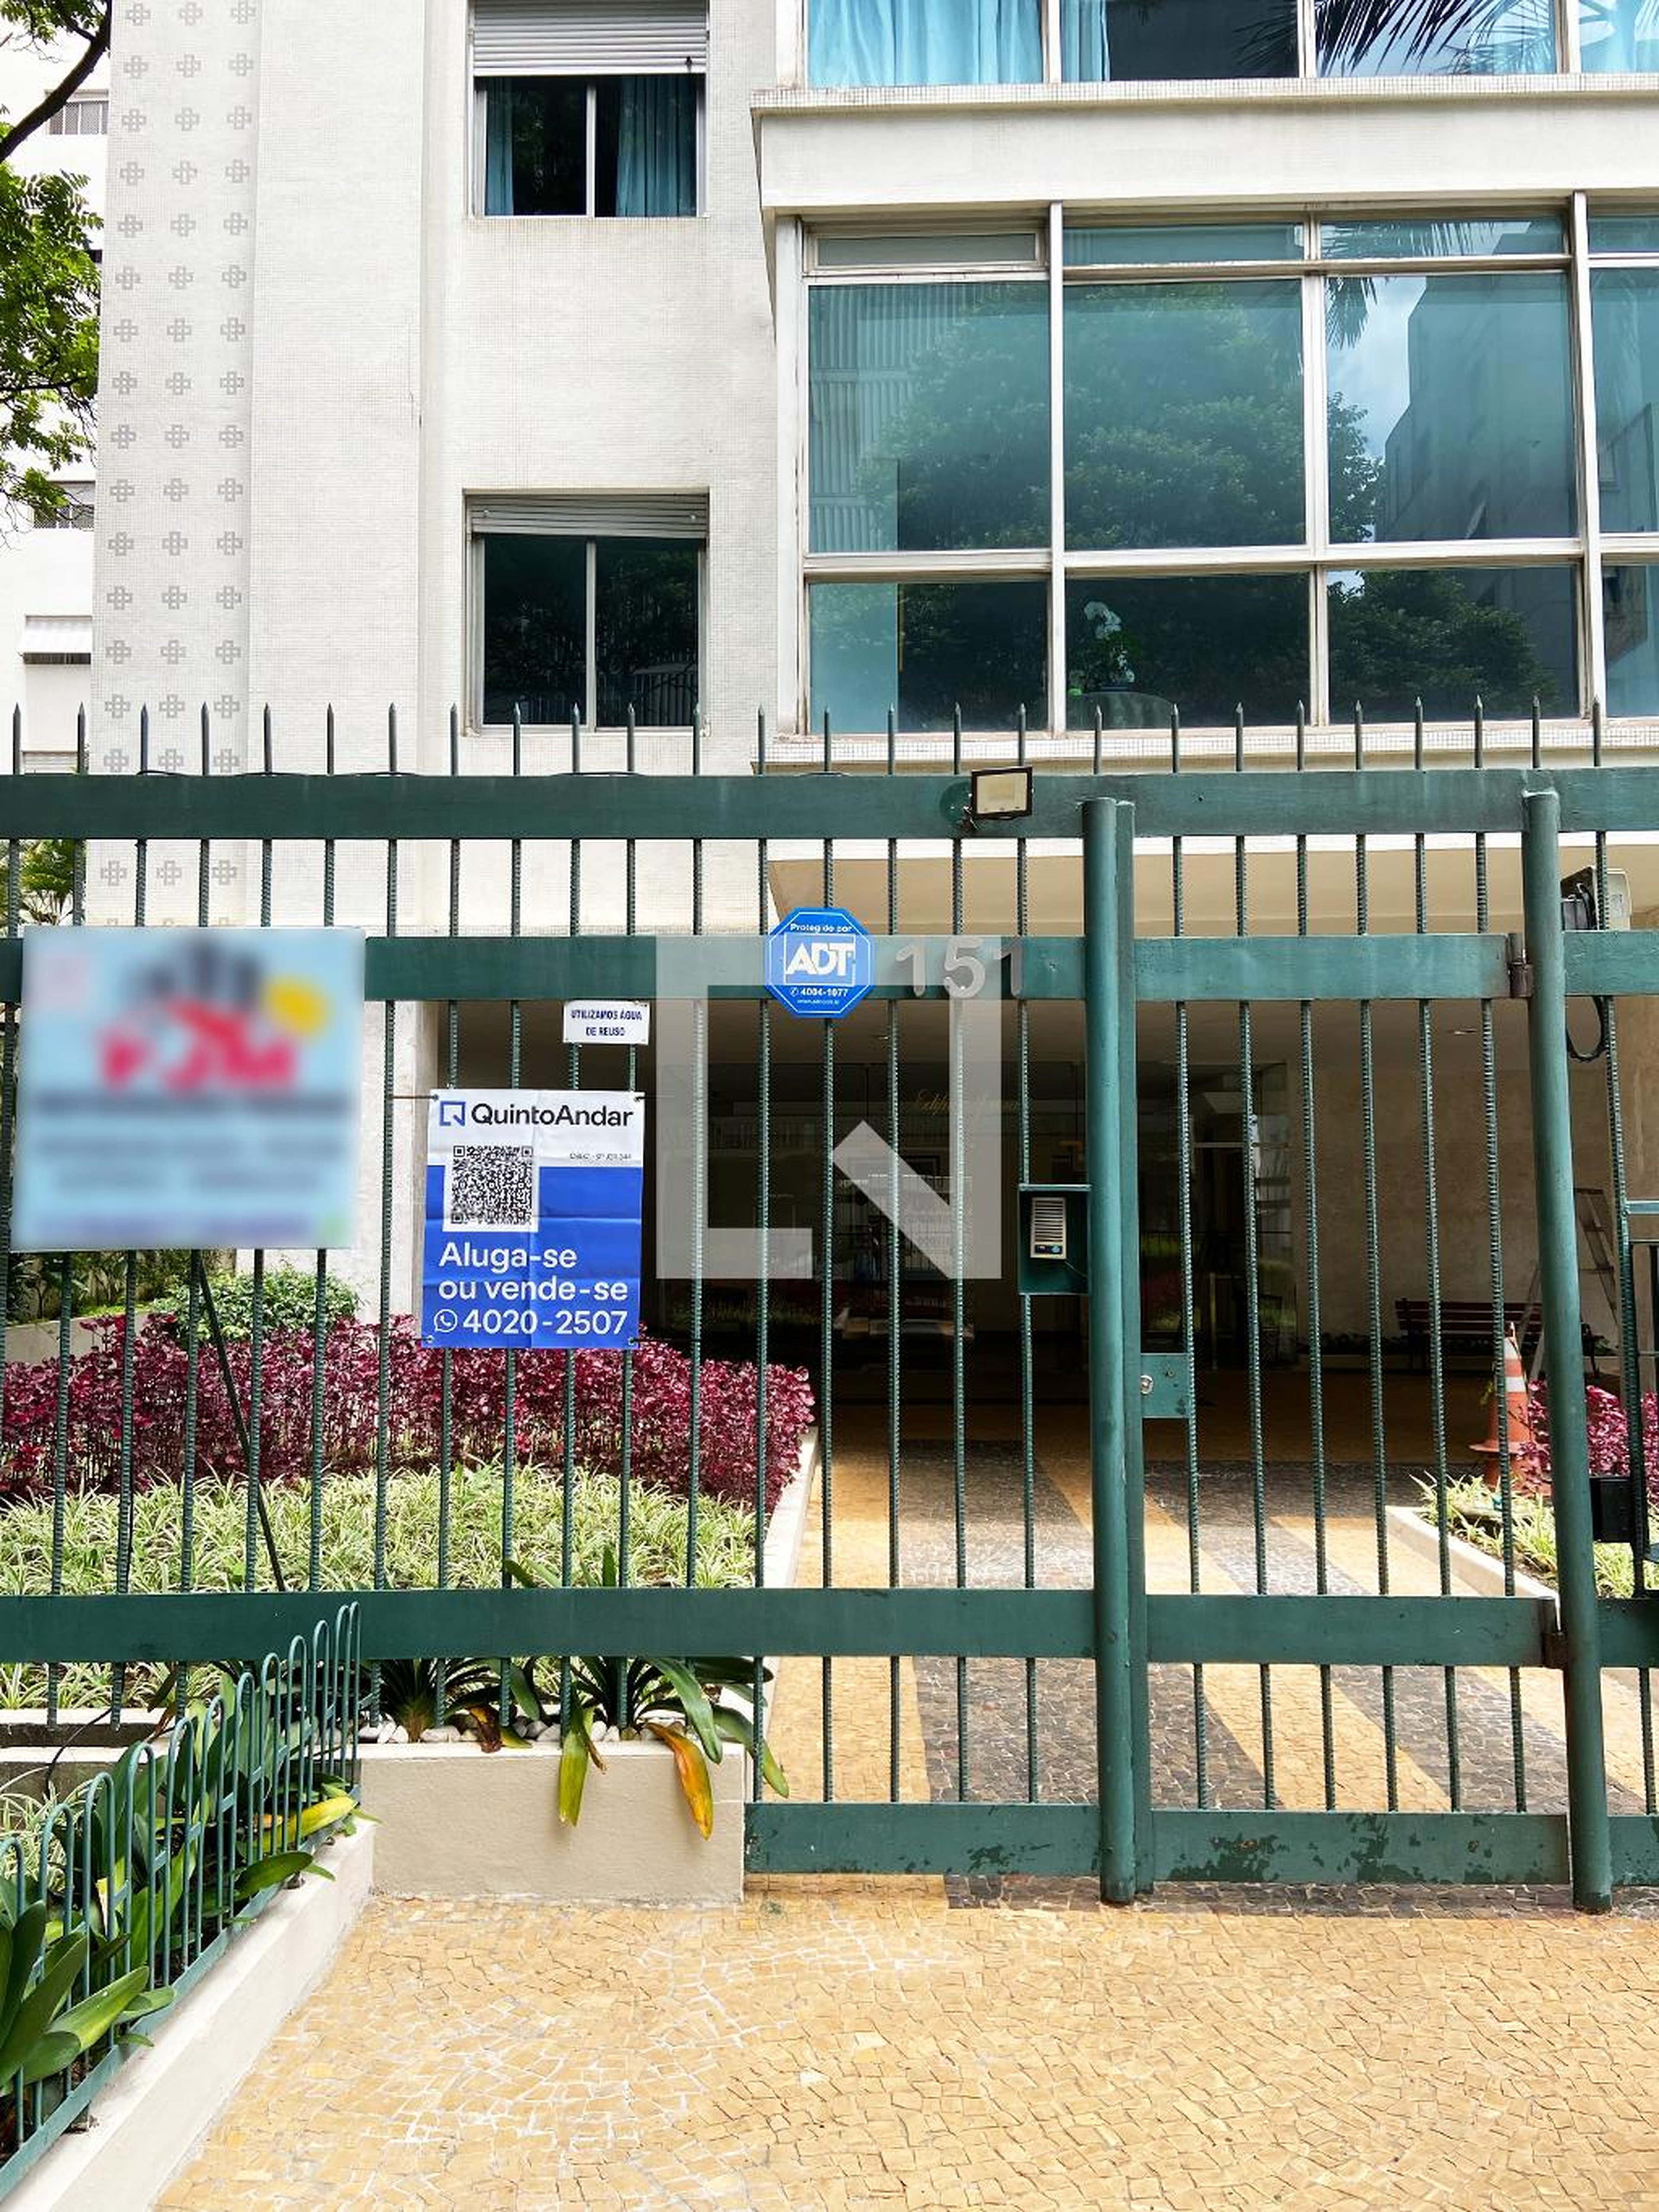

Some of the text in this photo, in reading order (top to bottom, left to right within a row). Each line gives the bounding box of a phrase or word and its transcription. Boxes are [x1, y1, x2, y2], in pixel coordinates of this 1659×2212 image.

[785, 942, 855, 976] ADT
[896, 936, 1023, 998] 151
[571, 1009, 618, 1020] UTILIZAMOS
[586, 1027, 625, 1036] DE REUSO
[471, 1103, 634, 1127] QuintoAndar
[439, 1241, 577, 1272] Aluga-se
[438, 1276, 628, 1301] ou vende-se
[462, 1309, 628, 1335] 4020-2507
